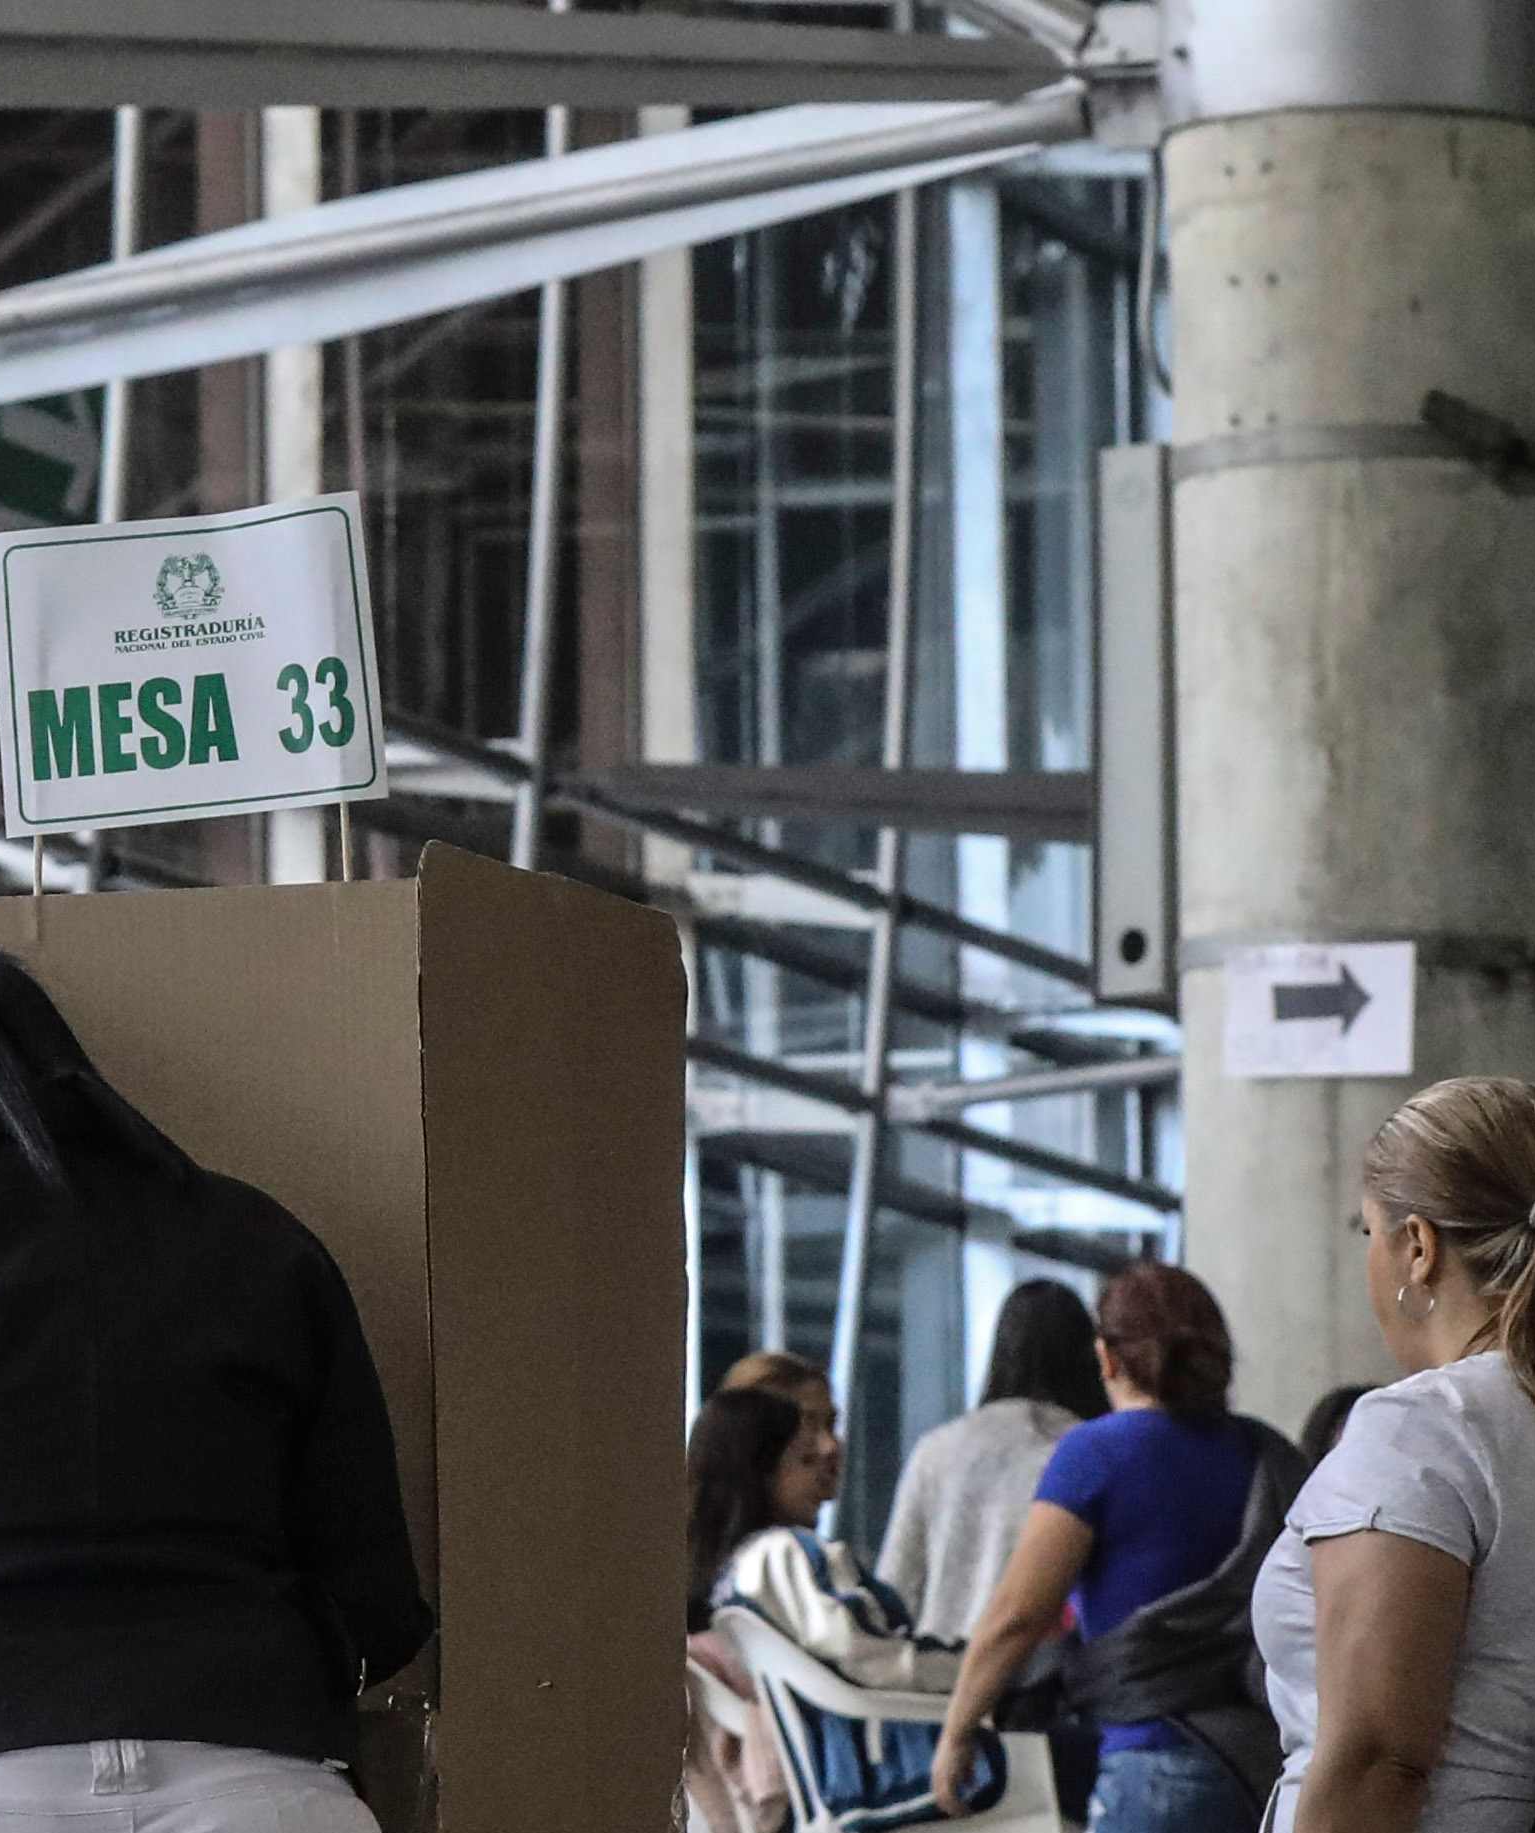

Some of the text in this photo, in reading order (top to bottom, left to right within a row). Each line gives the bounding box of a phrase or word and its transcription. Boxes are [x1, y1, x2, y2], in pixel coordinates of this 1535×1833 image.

[114, 613, 266, 644] REGISTRADURÍA
[114, 631, 266, 655] NACIONAL DEL ESTADO CIVIL
[27, 656, 356, 781] MESA 33
